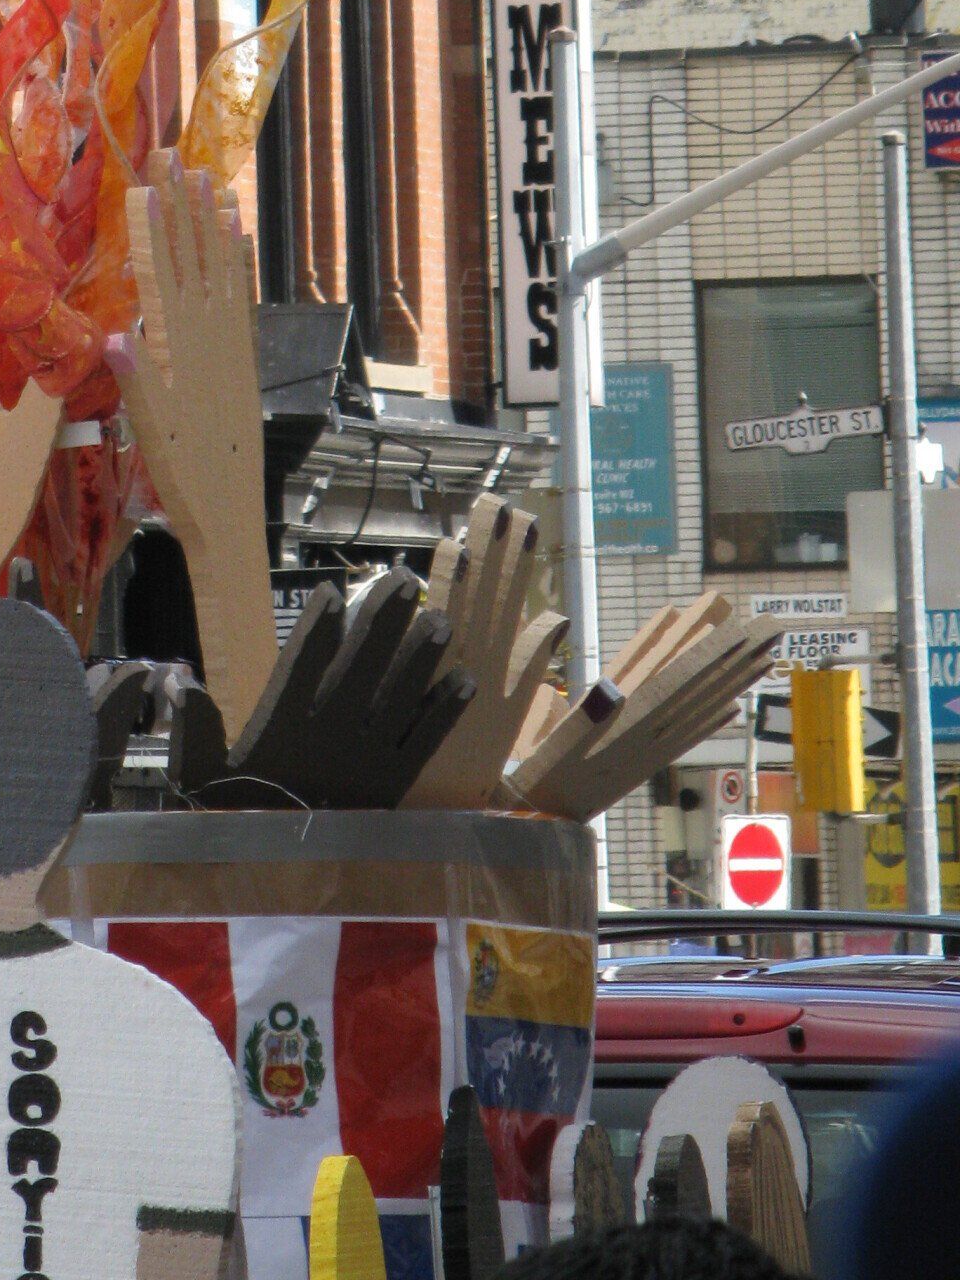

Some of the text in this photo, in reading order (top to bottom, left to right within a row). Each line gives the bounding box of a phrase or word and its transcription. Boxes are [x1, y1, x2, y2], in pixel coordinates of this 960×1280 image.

[732, 410, 880, 447] GLOUCESTER ST.
[756, 598, 843, 614] LARRY WOLSTAT
[790, 632, 858, 645] LEASING
[789, 645, 841, 658] FLOOR
